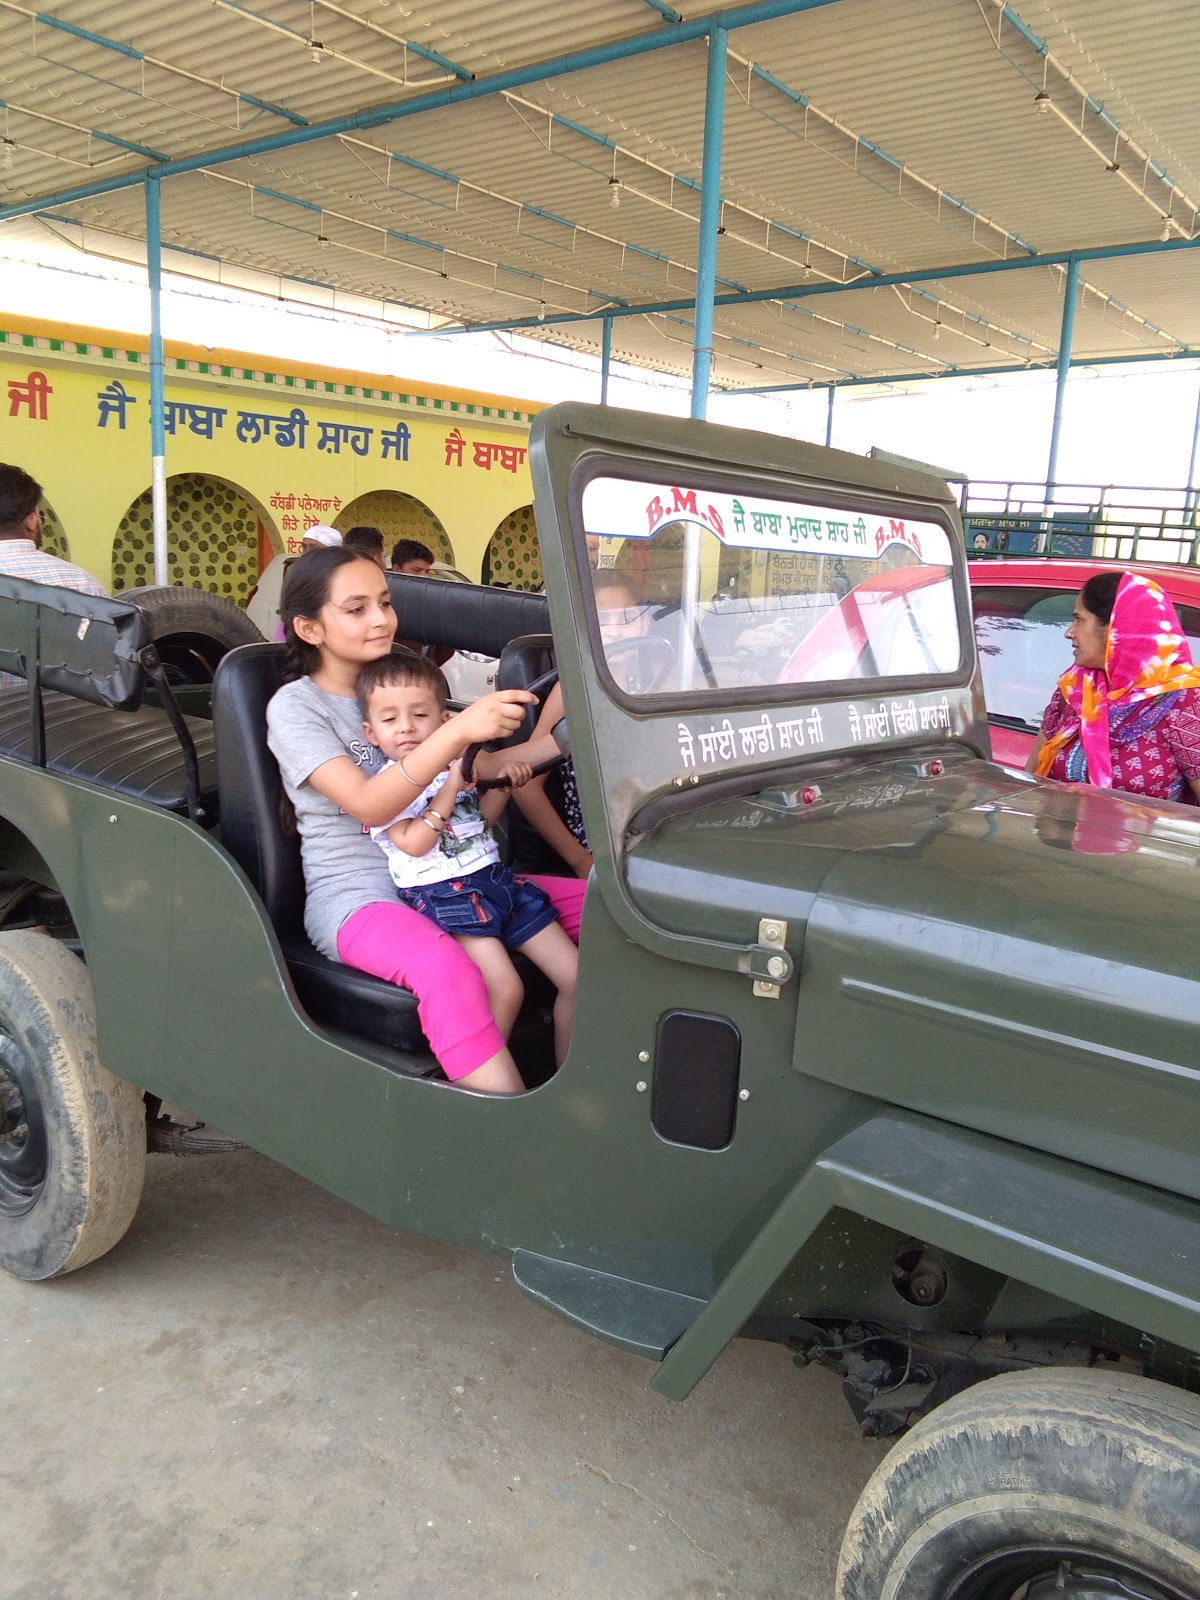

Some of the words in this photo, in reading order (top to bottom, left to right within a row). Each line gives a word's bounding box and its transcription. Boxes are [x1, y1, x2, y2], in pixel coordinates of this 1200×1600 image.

[7, 370, 54, 421] ਜੀ
[96, 379, 137, 430] ਜੈ
[236, 408, 309, 450] ਲਾਡੀ
[317, 420, 374, 458] ਸ਼ਾਹ
[380, 421, 412, 462] ਜੀ
[444, 427, 466, 467] ਜੈ
[472, 440, 528, 474] ਬਾਬਾ
[732, 498, 746, 533] ਜੈ
[750, 511, 782, 537] ਬਾਬਾ
[786, 515, 823, 544] ਮੁਰਾਦ
[825, 520, 849, 543] ਸ਼ਾਹ
[853, 516, 867, 546] ਜੀ
[677, 722, 696, 767] ਜੈ
[738, 713, 775, 756] ਲਾਡੀ
[776, 719, 805, 749] ਸ਼ਾਹ
[806, 707, 824, 744] ਜੀ
[848, 704, 862, 741] ਜੈ
[938, 696, 951, 728] ਜੀ
